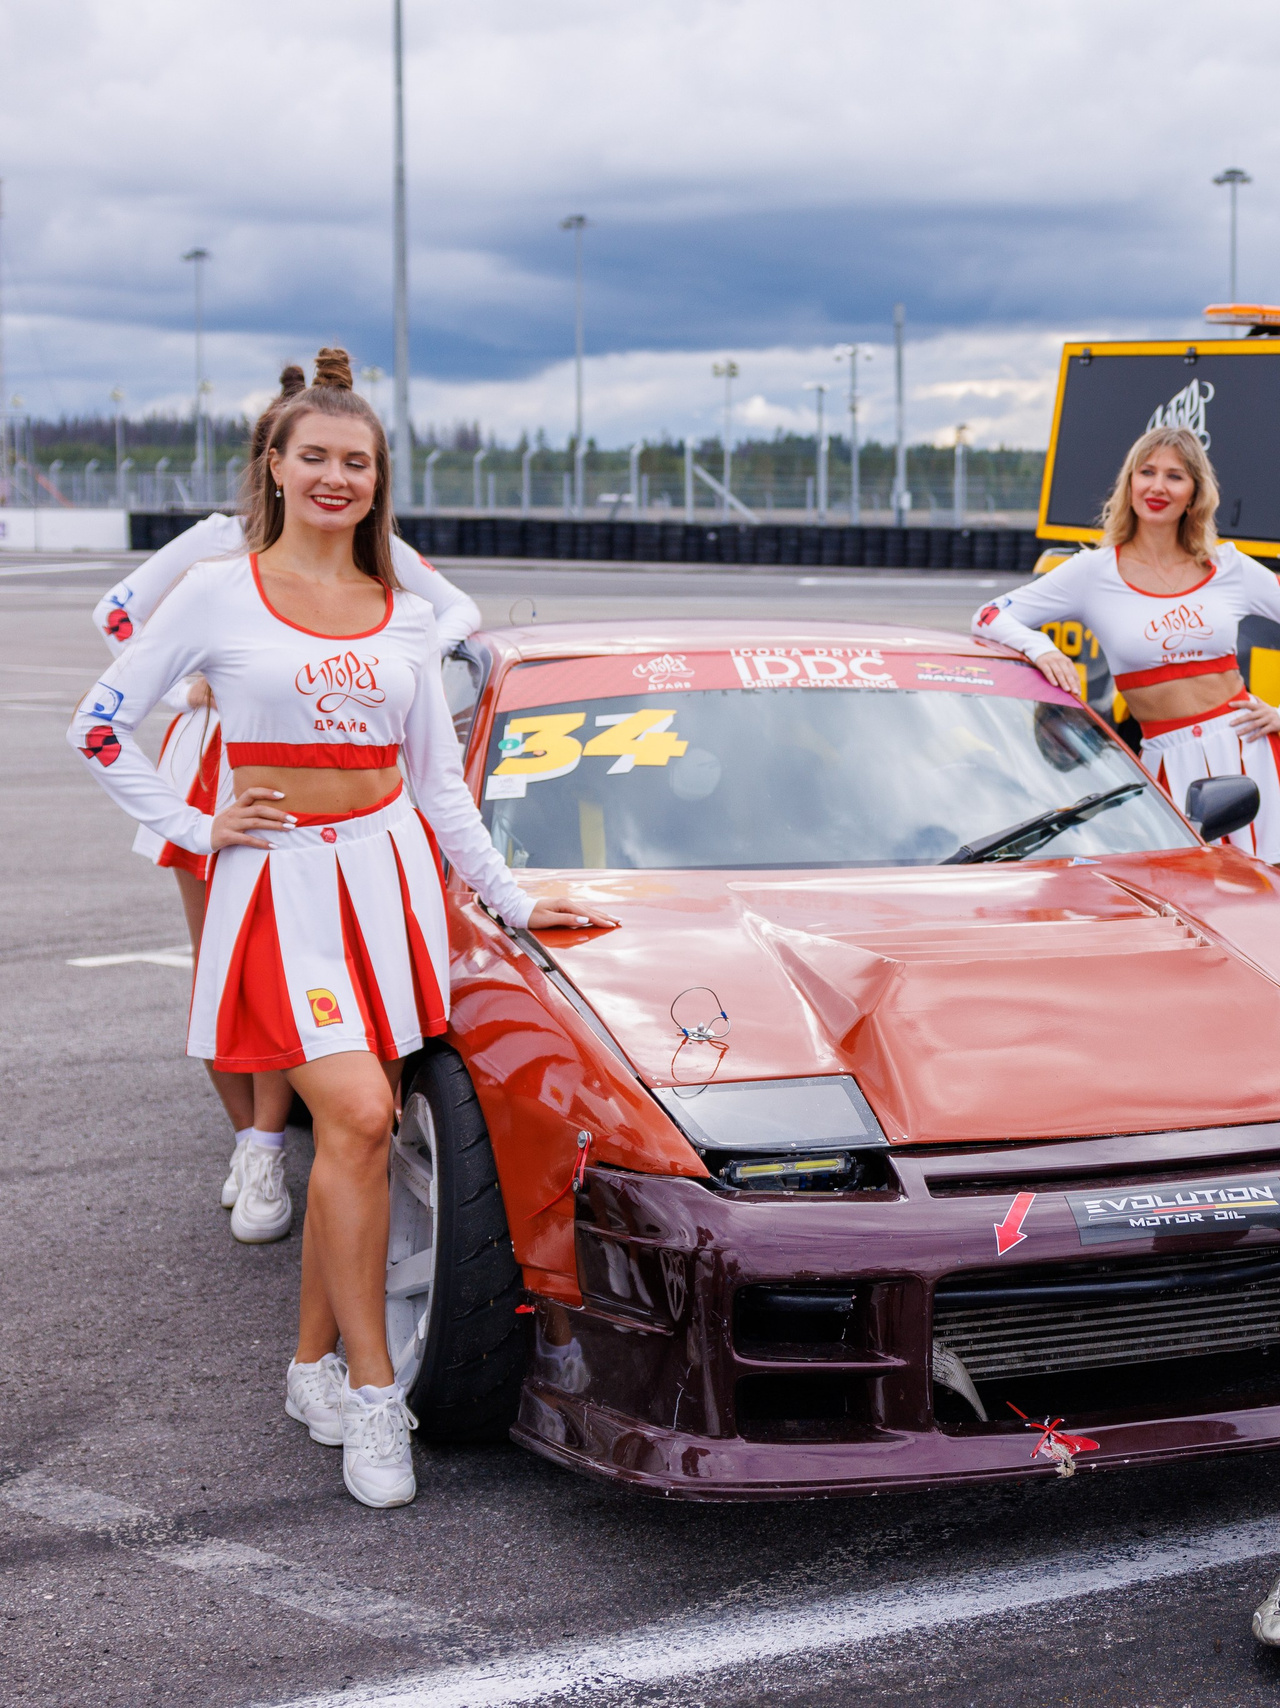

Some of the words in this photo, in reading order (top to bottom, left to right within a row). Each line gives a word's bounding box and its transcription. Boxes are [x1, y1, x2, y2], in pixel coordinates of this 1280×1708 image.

[729, 648, 803, 658] IGORA
[814, 648, 883, 659] DRIVE
[732, 656, 893, 681] IDDC
[742, 679, 794, 688] DRIFT
[797, 679, 899, 689] CHALLENGE
[314, 719, 367, 732] ДРАЙВ
[492, 709, 689, 776] 34
[1084, 1186, 1274, 1214] EVOLUTION
[1129, 1212, 1204, 1228] MOTOR
[1214, 1210, 1246, 1222] OIL
